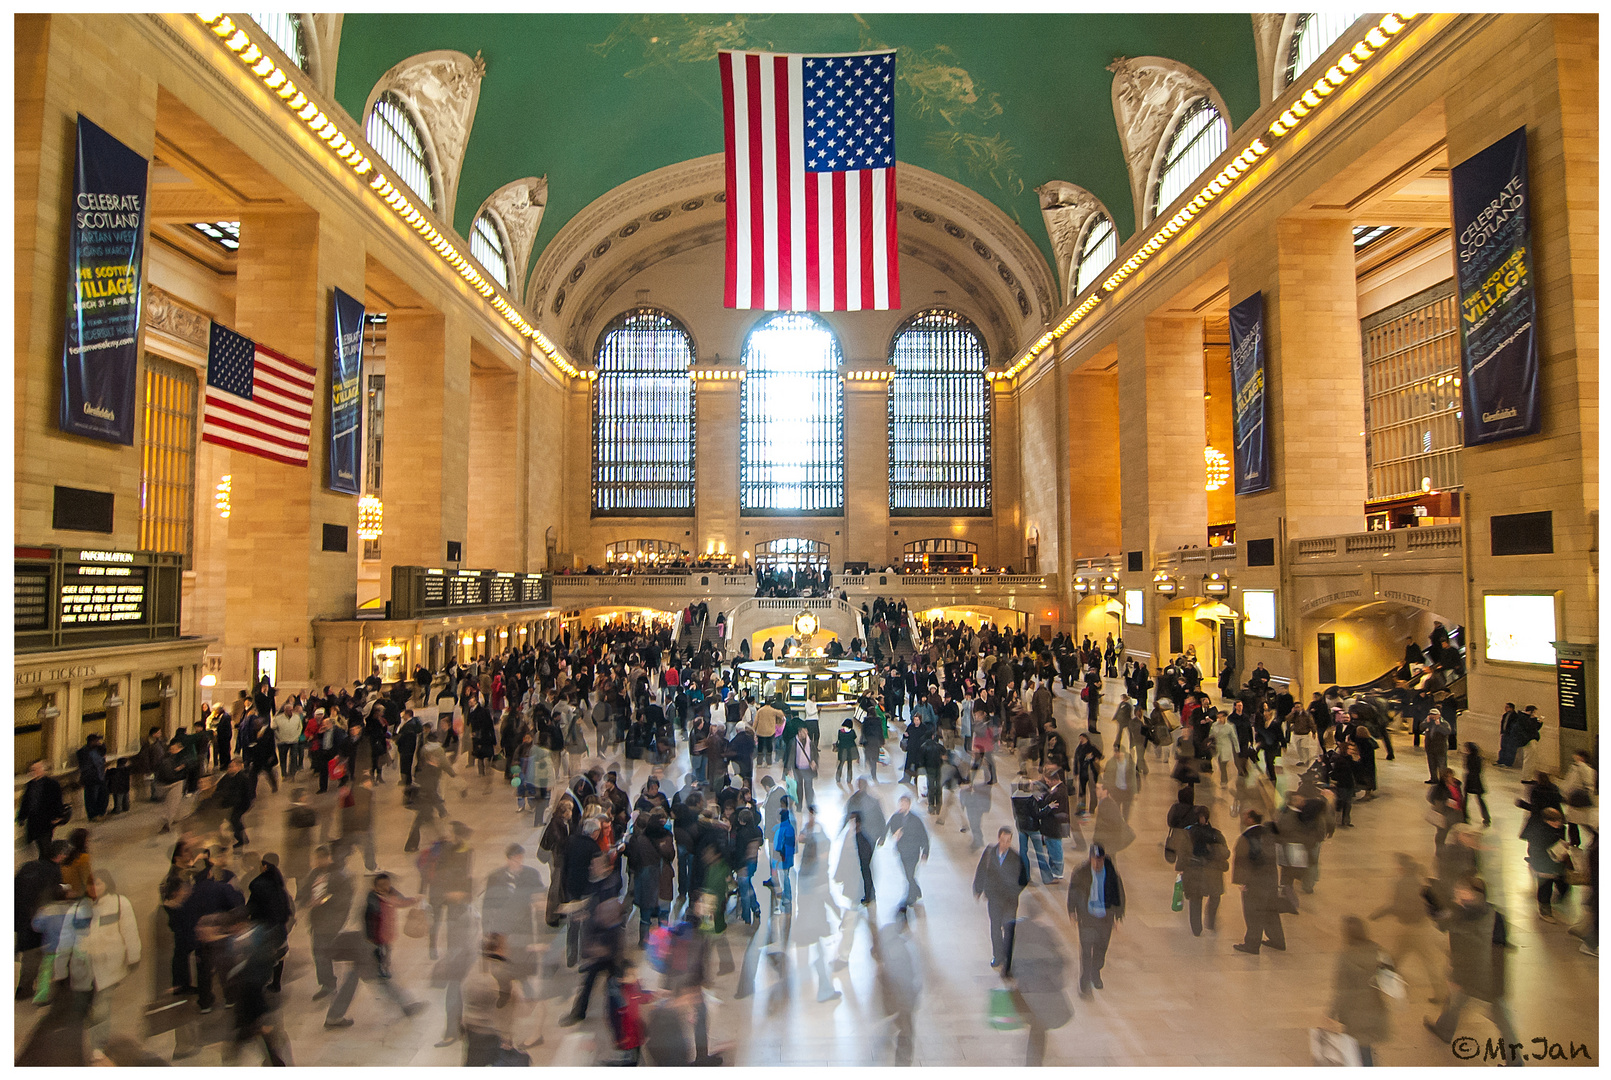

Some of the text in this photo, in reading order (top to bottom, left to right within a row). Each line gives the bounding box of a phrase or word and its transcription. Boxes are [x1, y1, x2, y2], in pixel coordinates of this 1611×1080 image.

[77, 192, 141, 211] CELEBRATE
[1460, 174, 1524, 245] CELEBRATE
[76, 212, 139, 229] SCOTLAND
[1460, 194, 1525, 263] SCOTLAND
[113, 230, 136, 243] WEE
[1462, 247, 1526, 309] THE SCOTTISH
[75, 278, 137, 298] VILLAGE
[1463, 261, 1528, 323] VILLAGE
[80, 550, 134, 563] INFORMATION
[1402, 592, 1431, 607] STREET
[14, 665, 97, 684] RTH TICKETS
